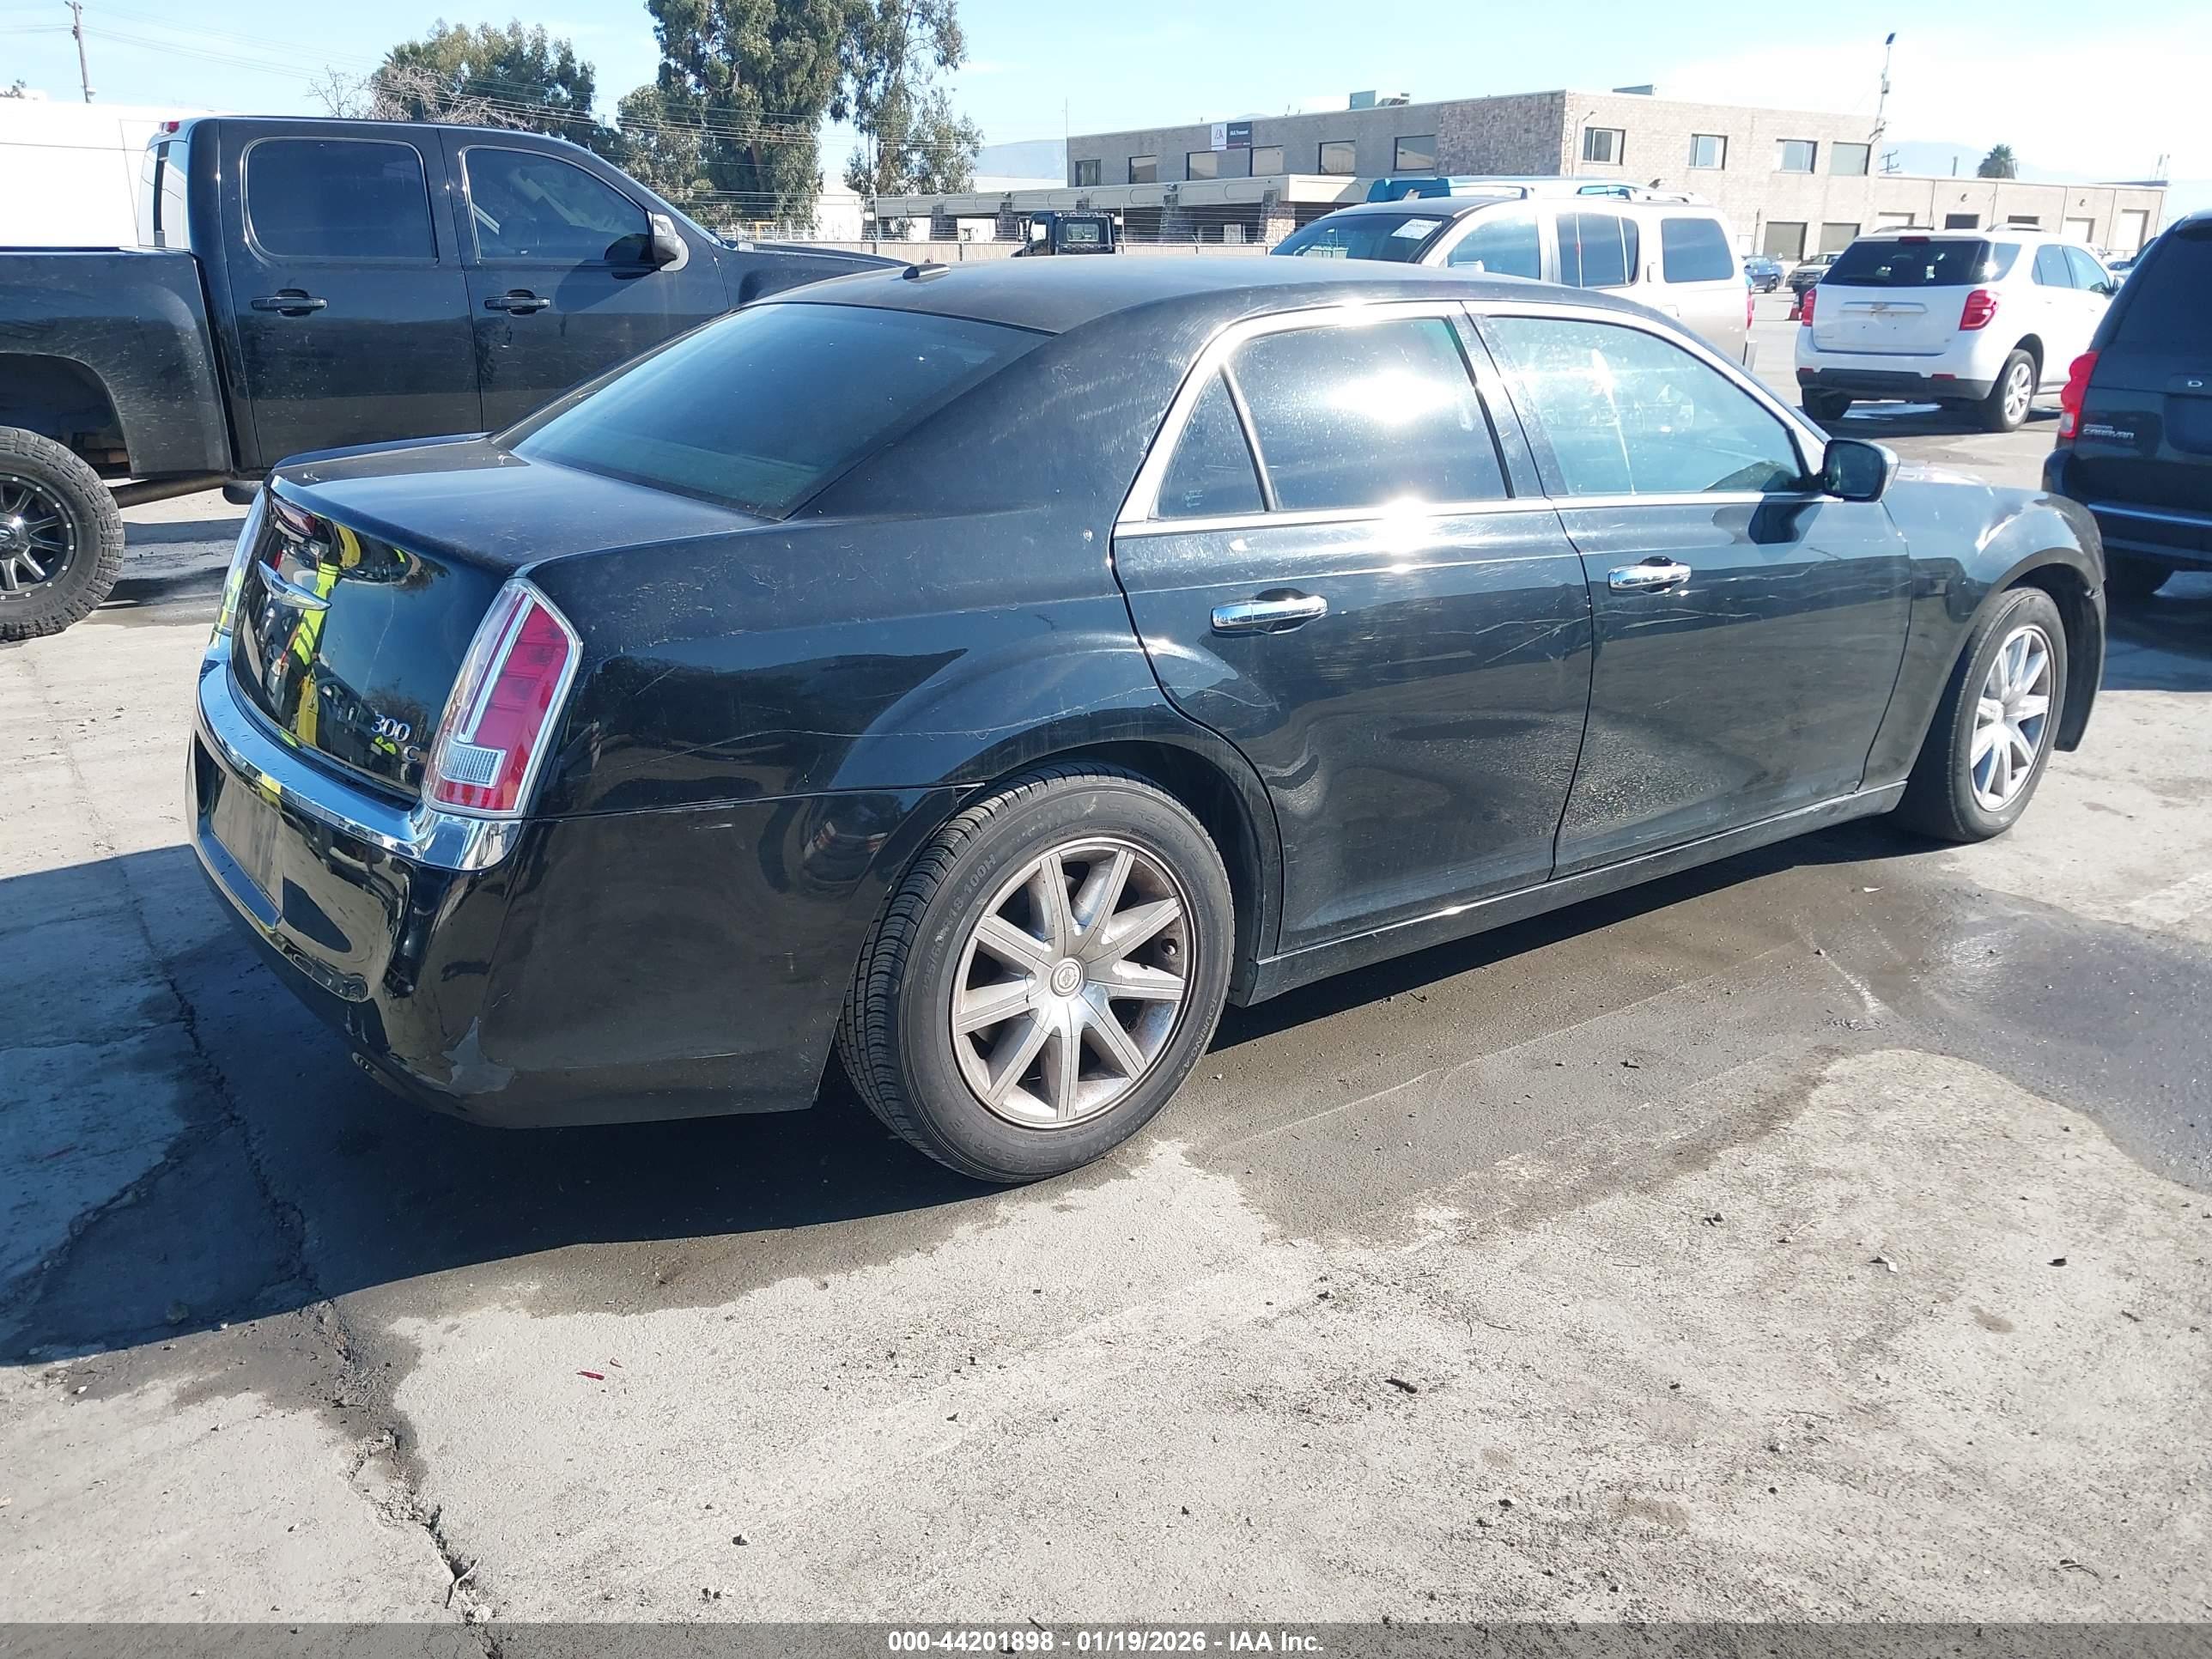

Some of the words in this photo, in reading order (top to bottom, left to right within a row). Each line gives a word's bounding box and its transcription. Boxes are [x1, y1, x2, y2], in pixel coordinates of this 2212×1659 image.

[370, 714, 410, 742] 300
[403, 745, 421, 762] C
[963, 854, 997, 895] 100H
[1191, 998, 1218, 1057] TOURING
